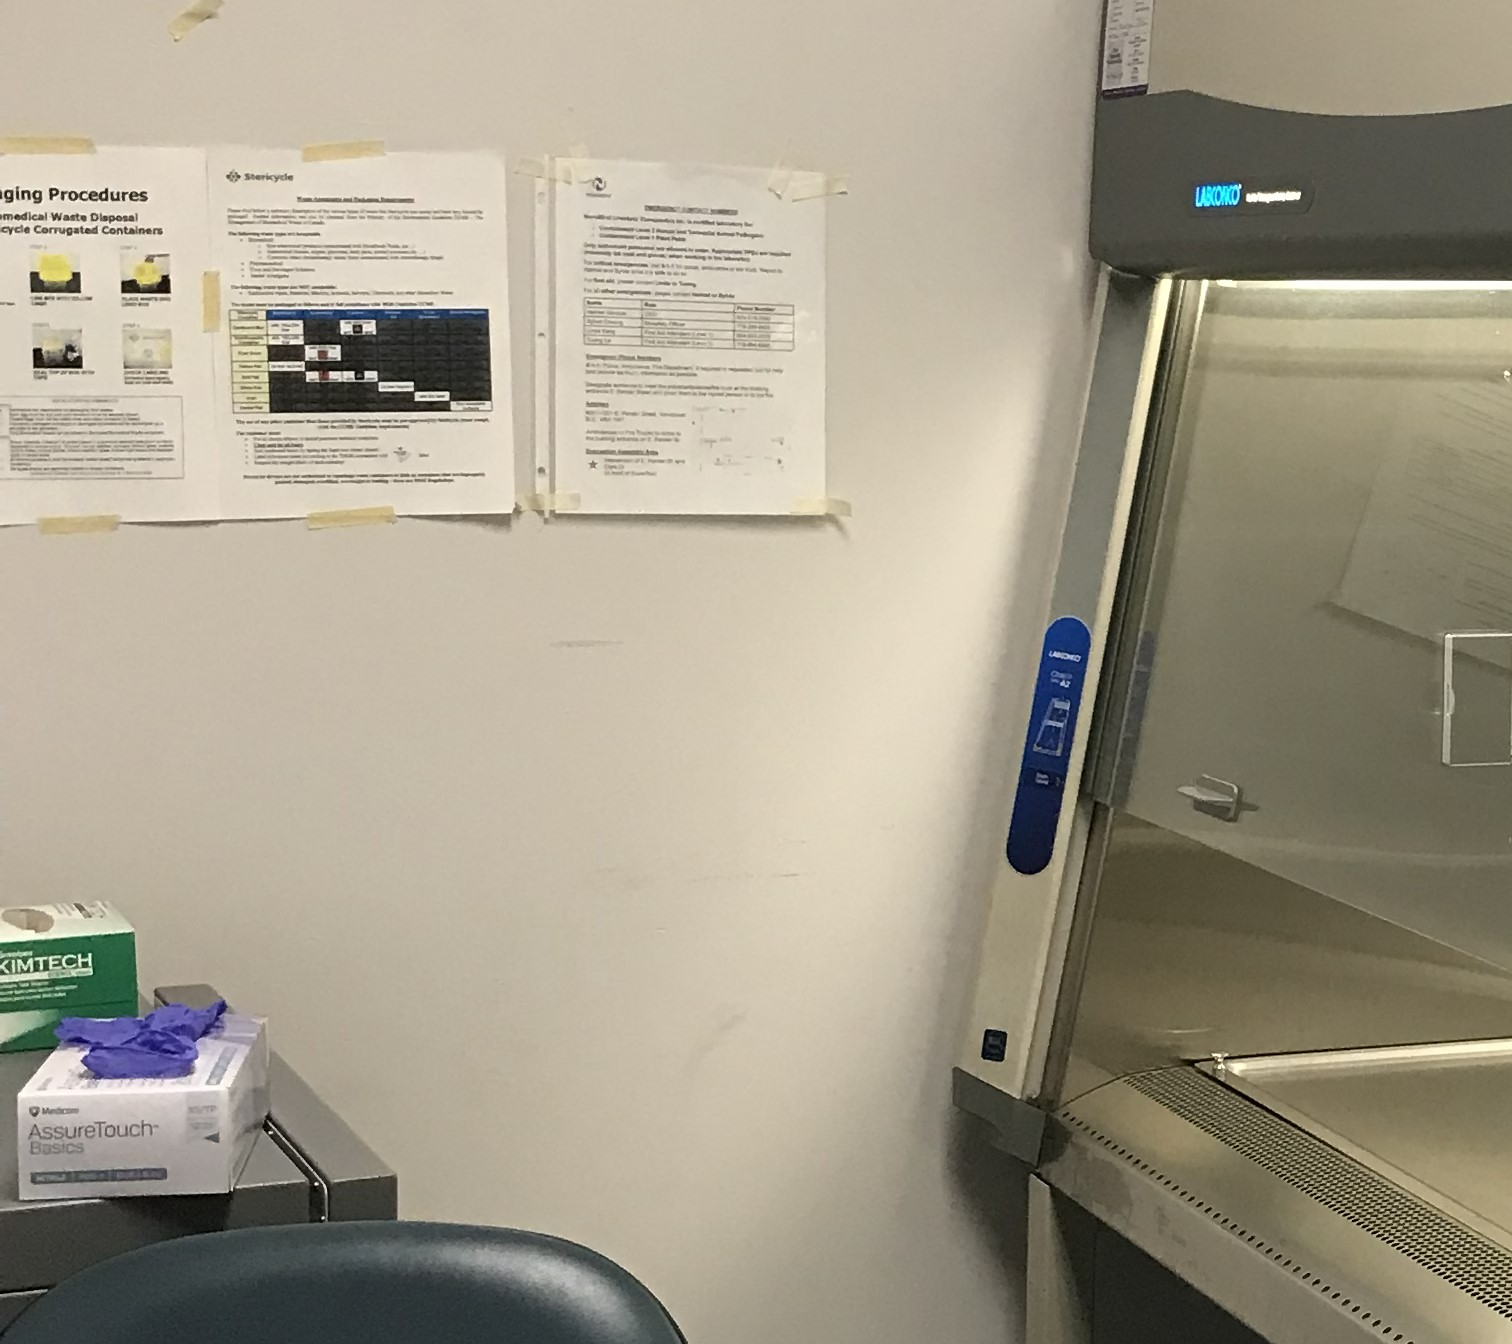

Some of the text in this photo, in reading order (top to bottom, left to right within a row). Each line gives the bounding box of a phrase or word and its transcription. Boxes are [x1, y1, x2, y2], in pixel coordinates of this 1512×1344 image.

[244, 172, 294, 183] Stericycle
[49, 187, 149, 202] Procedures
[51, 212, 87, 222] Waste
[90, 212, 138, 224] Disposal
[33, 225, 98, 236] Corrugated
[101, 225, 164, 236] Containers
[28, 1120, 154, 1141] AssureTouch
[30, 1141, 84, 1155] Basics
